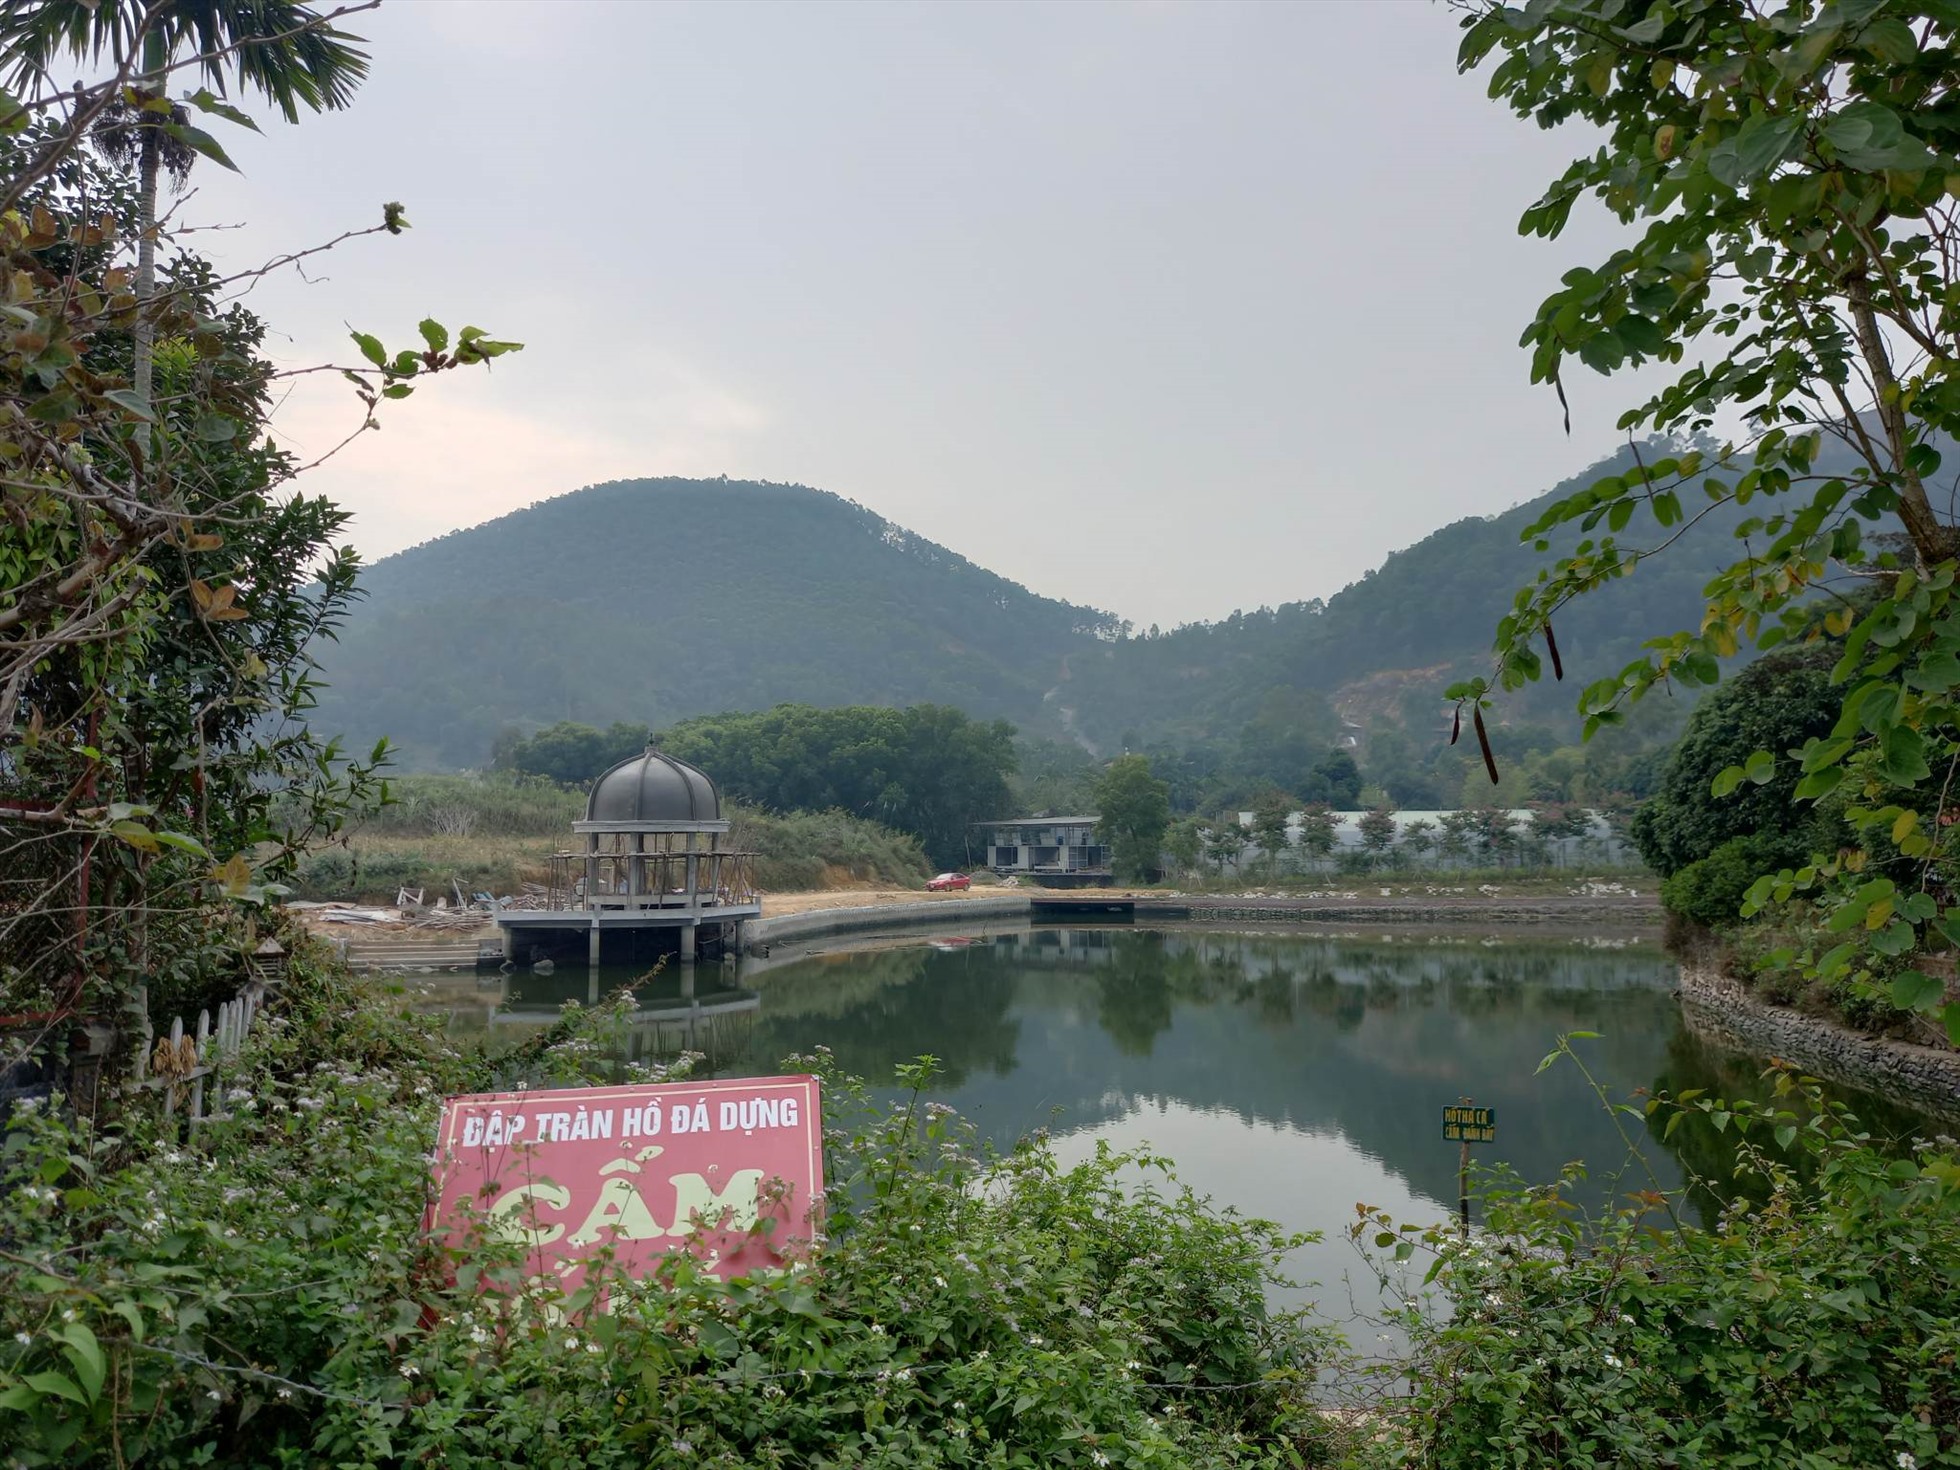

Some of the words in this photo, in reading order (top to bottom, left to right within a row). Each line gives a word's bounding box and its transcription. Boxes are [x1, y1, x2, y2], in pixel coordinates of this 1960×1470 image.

[463, 1110, 526, 1153] ĐẬP
[536, 1105, 613, 1143] TRÀN
[622, 1097, 662, 1137] HỒ
[671, 1098, 710, 1134] ĐÁ
[720, 1097, 798, 1135] DỰNG
[488, 1146, 765, 1247] CẤM
